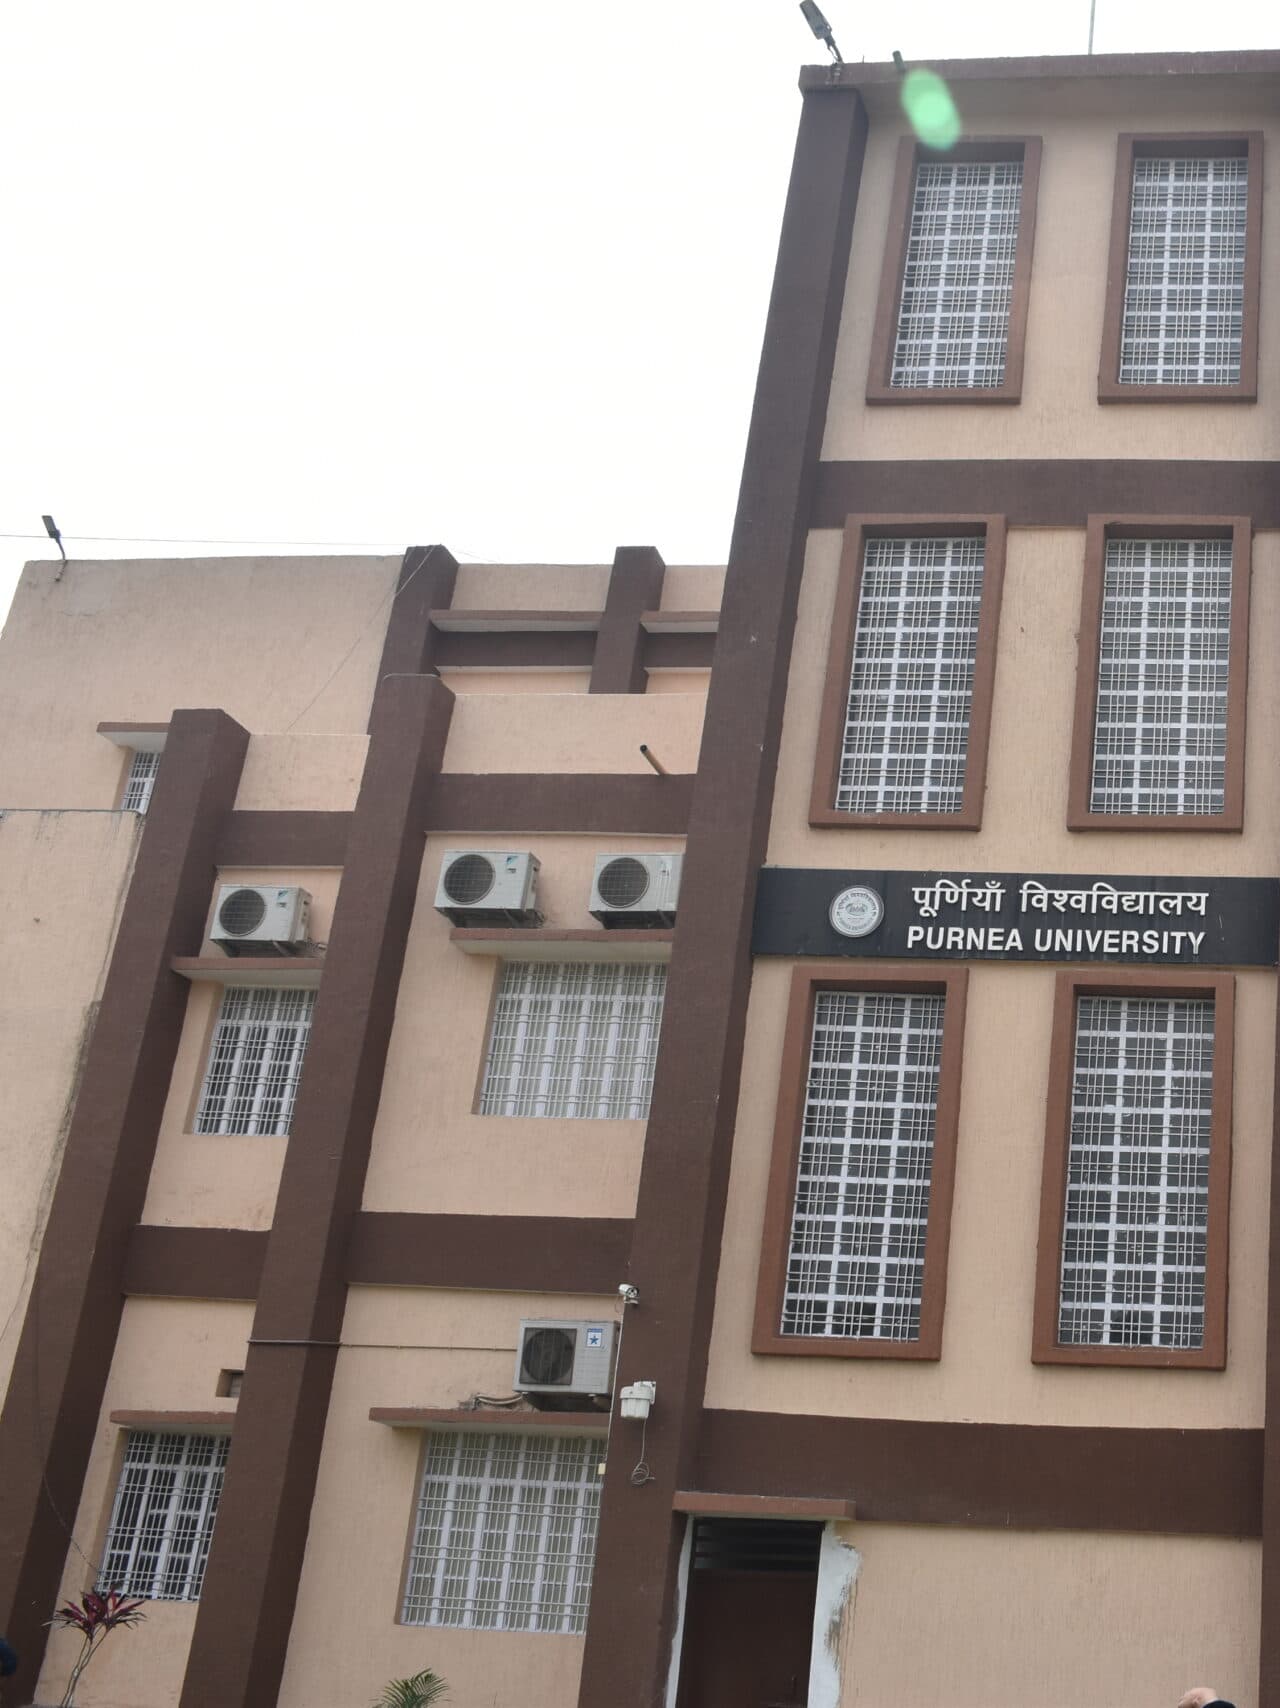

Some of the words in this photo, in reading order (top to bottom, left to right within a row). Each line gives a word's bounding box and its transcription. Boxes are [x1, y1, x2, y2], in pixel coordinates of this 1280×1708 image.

[1019, 880, 1210, 916] विश्वविद्यालय
[907, 925, 1024, 951] PURNEA
[1034, 928, 1206, 955] UNIVERSITY
